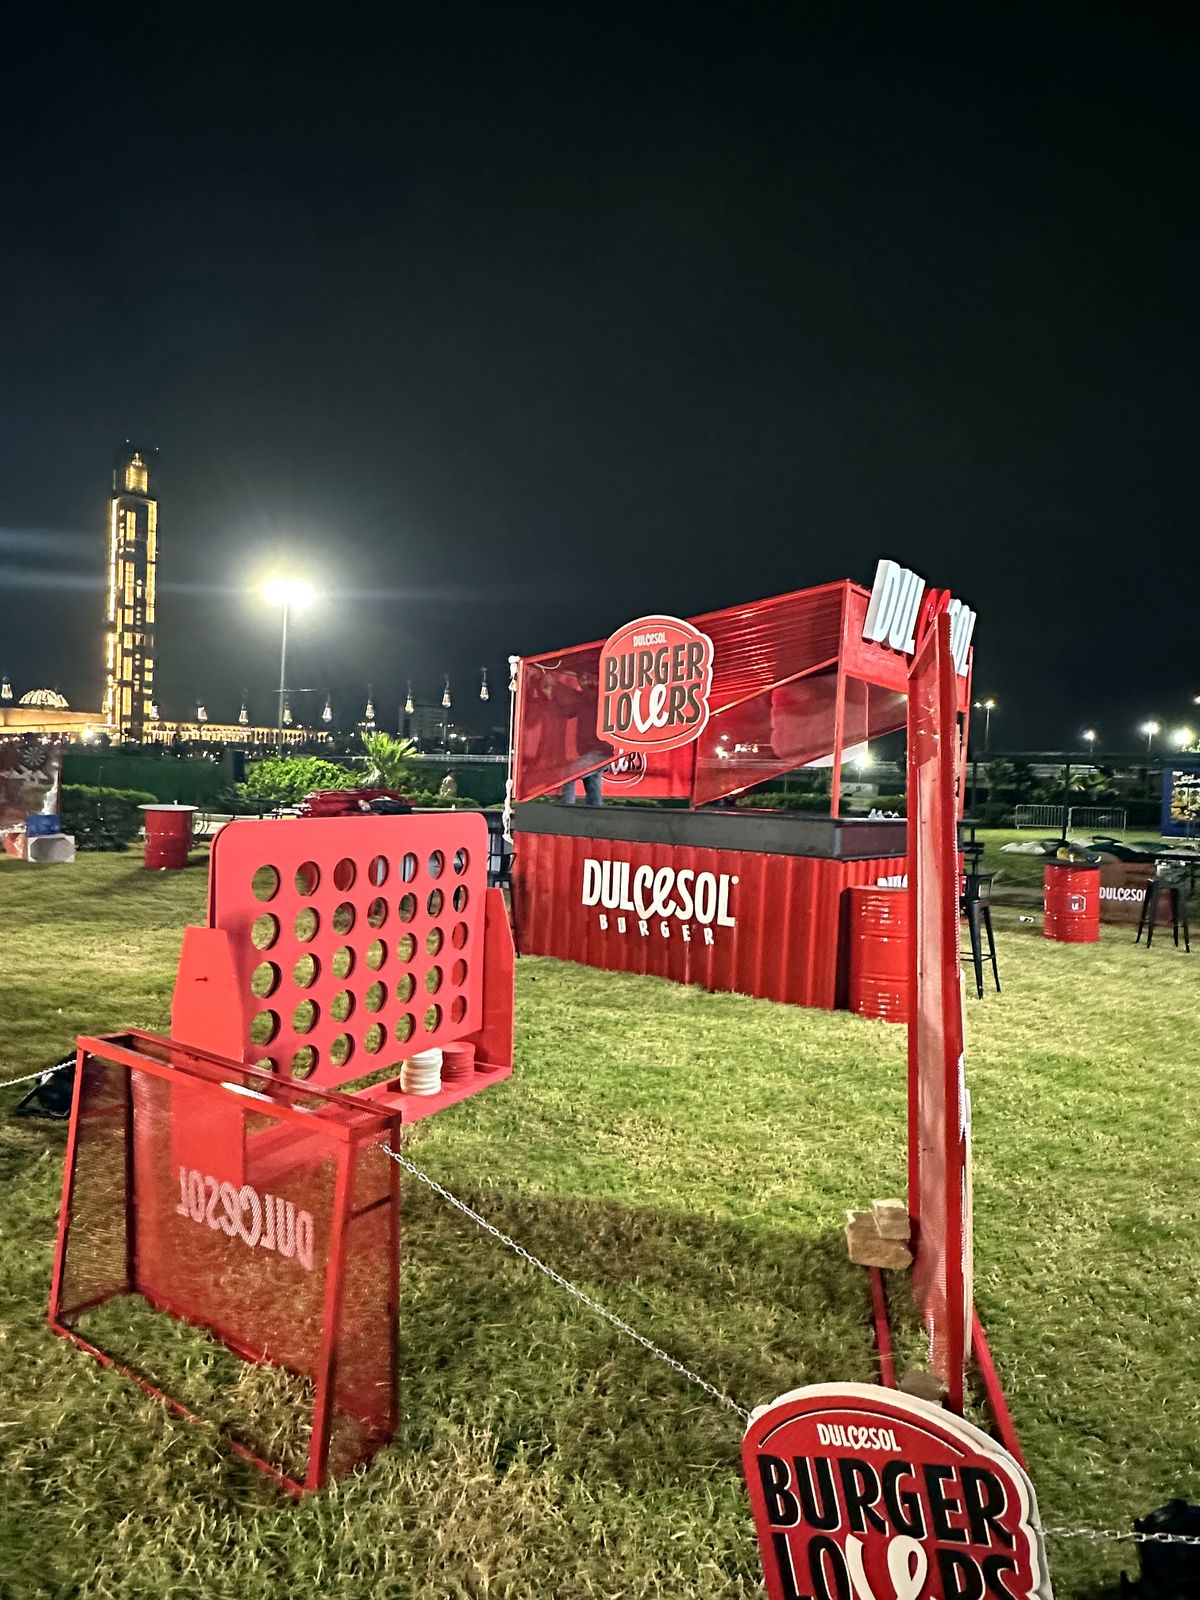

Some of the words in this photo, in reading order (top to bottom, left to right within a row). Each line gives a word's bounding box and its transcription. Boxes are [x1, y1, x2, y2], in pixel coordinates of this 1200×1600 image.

[604, 641, 704, 693] BURGER
[599, 913, 714, 945] BURGER
[757, 1454, 1017, 1552] BURGER
